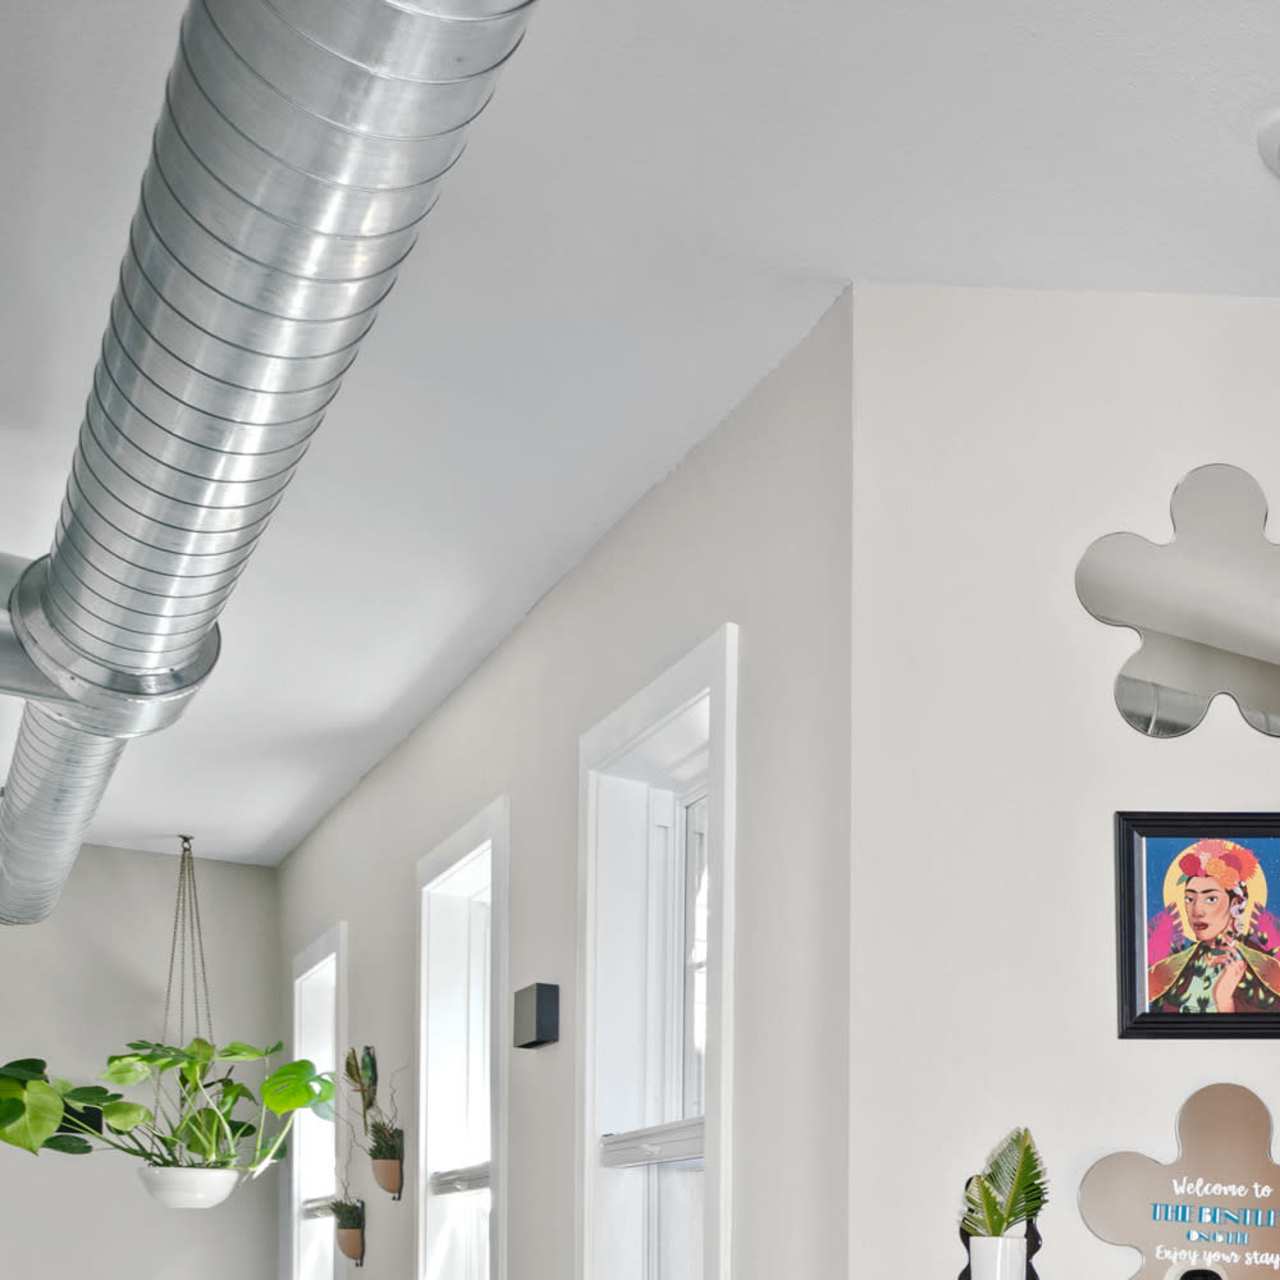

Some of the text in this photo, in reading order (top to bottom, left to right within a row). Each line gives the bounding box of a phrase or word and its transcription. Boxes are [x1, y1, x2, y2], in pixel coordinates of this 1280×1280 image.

[1171, 1176, 1273, 1199] Welcome to
[1155, 1243, 1199, 1266] Enjoy
[1202, 1249, 1241, 1267] your
